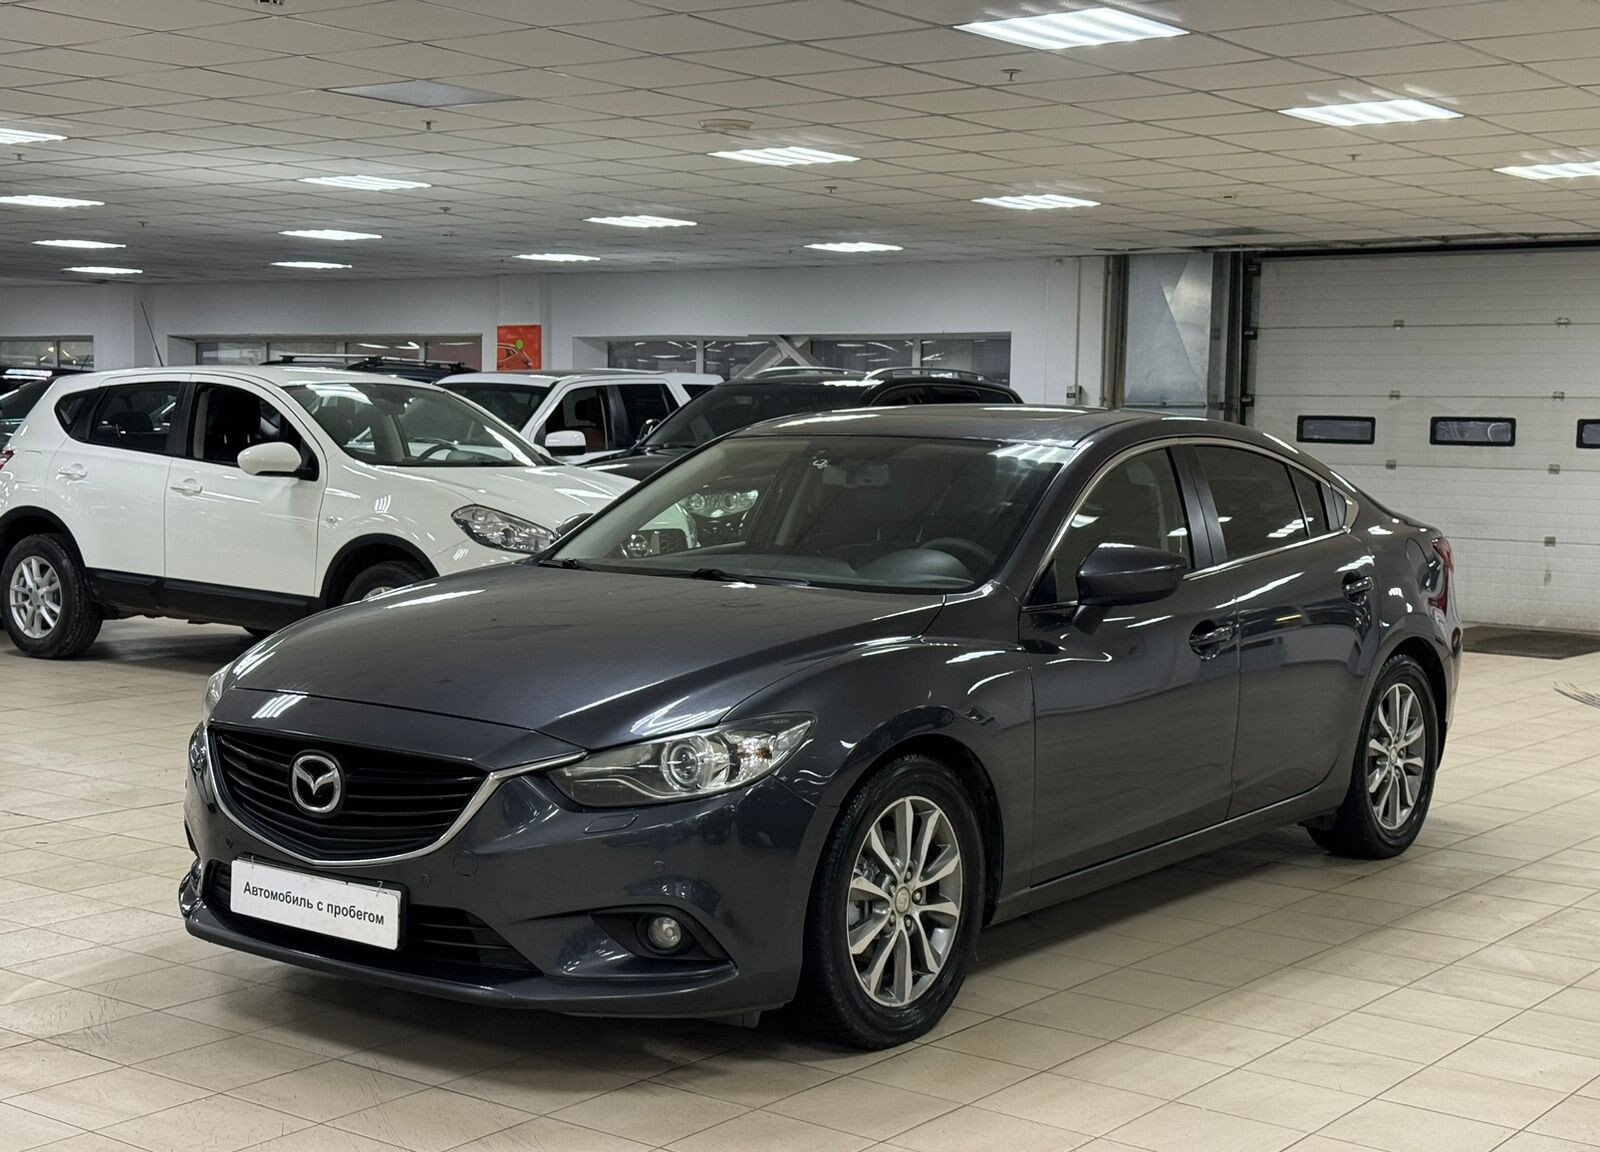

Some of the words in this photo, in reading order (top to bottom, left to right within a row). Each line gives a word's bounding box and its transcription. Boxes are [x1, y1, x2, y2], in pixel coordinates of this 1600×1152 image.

[243, 881, 314, 909] Автомобиль
[316, 901, 324, 911] с
[327, 903, 384, 925] пробегом
